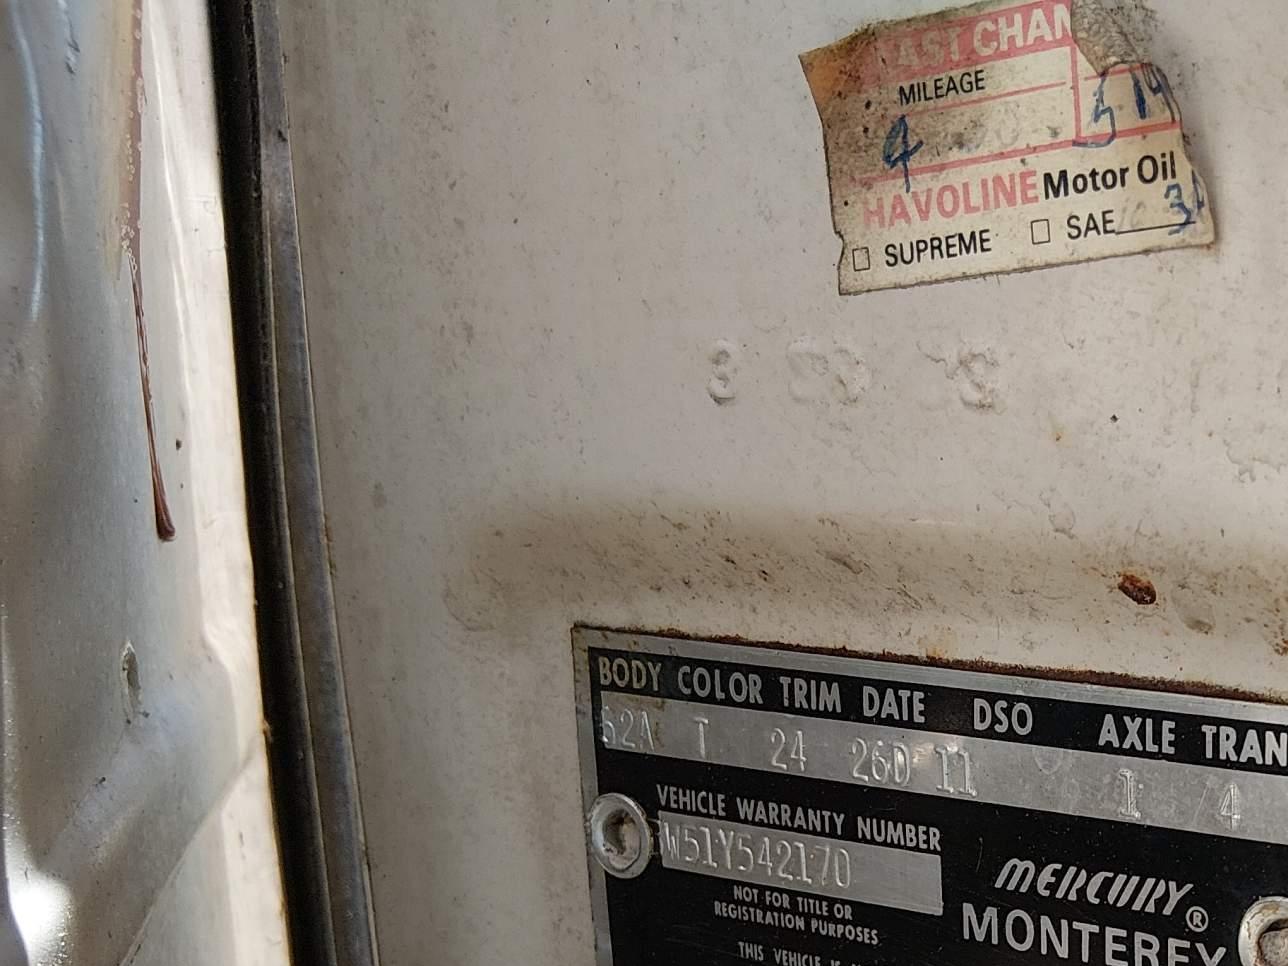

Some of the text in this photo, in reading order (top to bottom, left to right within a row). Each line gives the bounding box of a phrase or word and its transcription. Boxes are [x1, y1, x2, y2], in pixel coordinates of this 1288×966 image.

[898, 69, 985, 106] MILEAGE
[863, 151, 1177, 229] HAVOLINE Motor Oil
[1066, 210, 1116, 240] SAE
[884, 229, 992, 267] SUPREME
[599, 656, 662, 691] BODY
[677, 665, 764, 705] COLOR
[779, 676, 842, 713] TRIM
[862, 685, 926, 723] DATE
[973, 698, 1033, 735] DSO
[1098, 713, 1176, 754] AXLE
[694, 715, 709, 760] T
[771, 728, 807, 772] 24
[1118, 768, 1141, 820] 1
[1219, 783, 1241, 830] 4
[656, 784, 941, 851] VEHICLE WARRANTY NUMBER
[714, 900, 879, 945] REGISTRATION PURPOSES
[733, 885, 853, 921] NOT FOR TITLE OR
[738, 941, 764, 962] THIS
